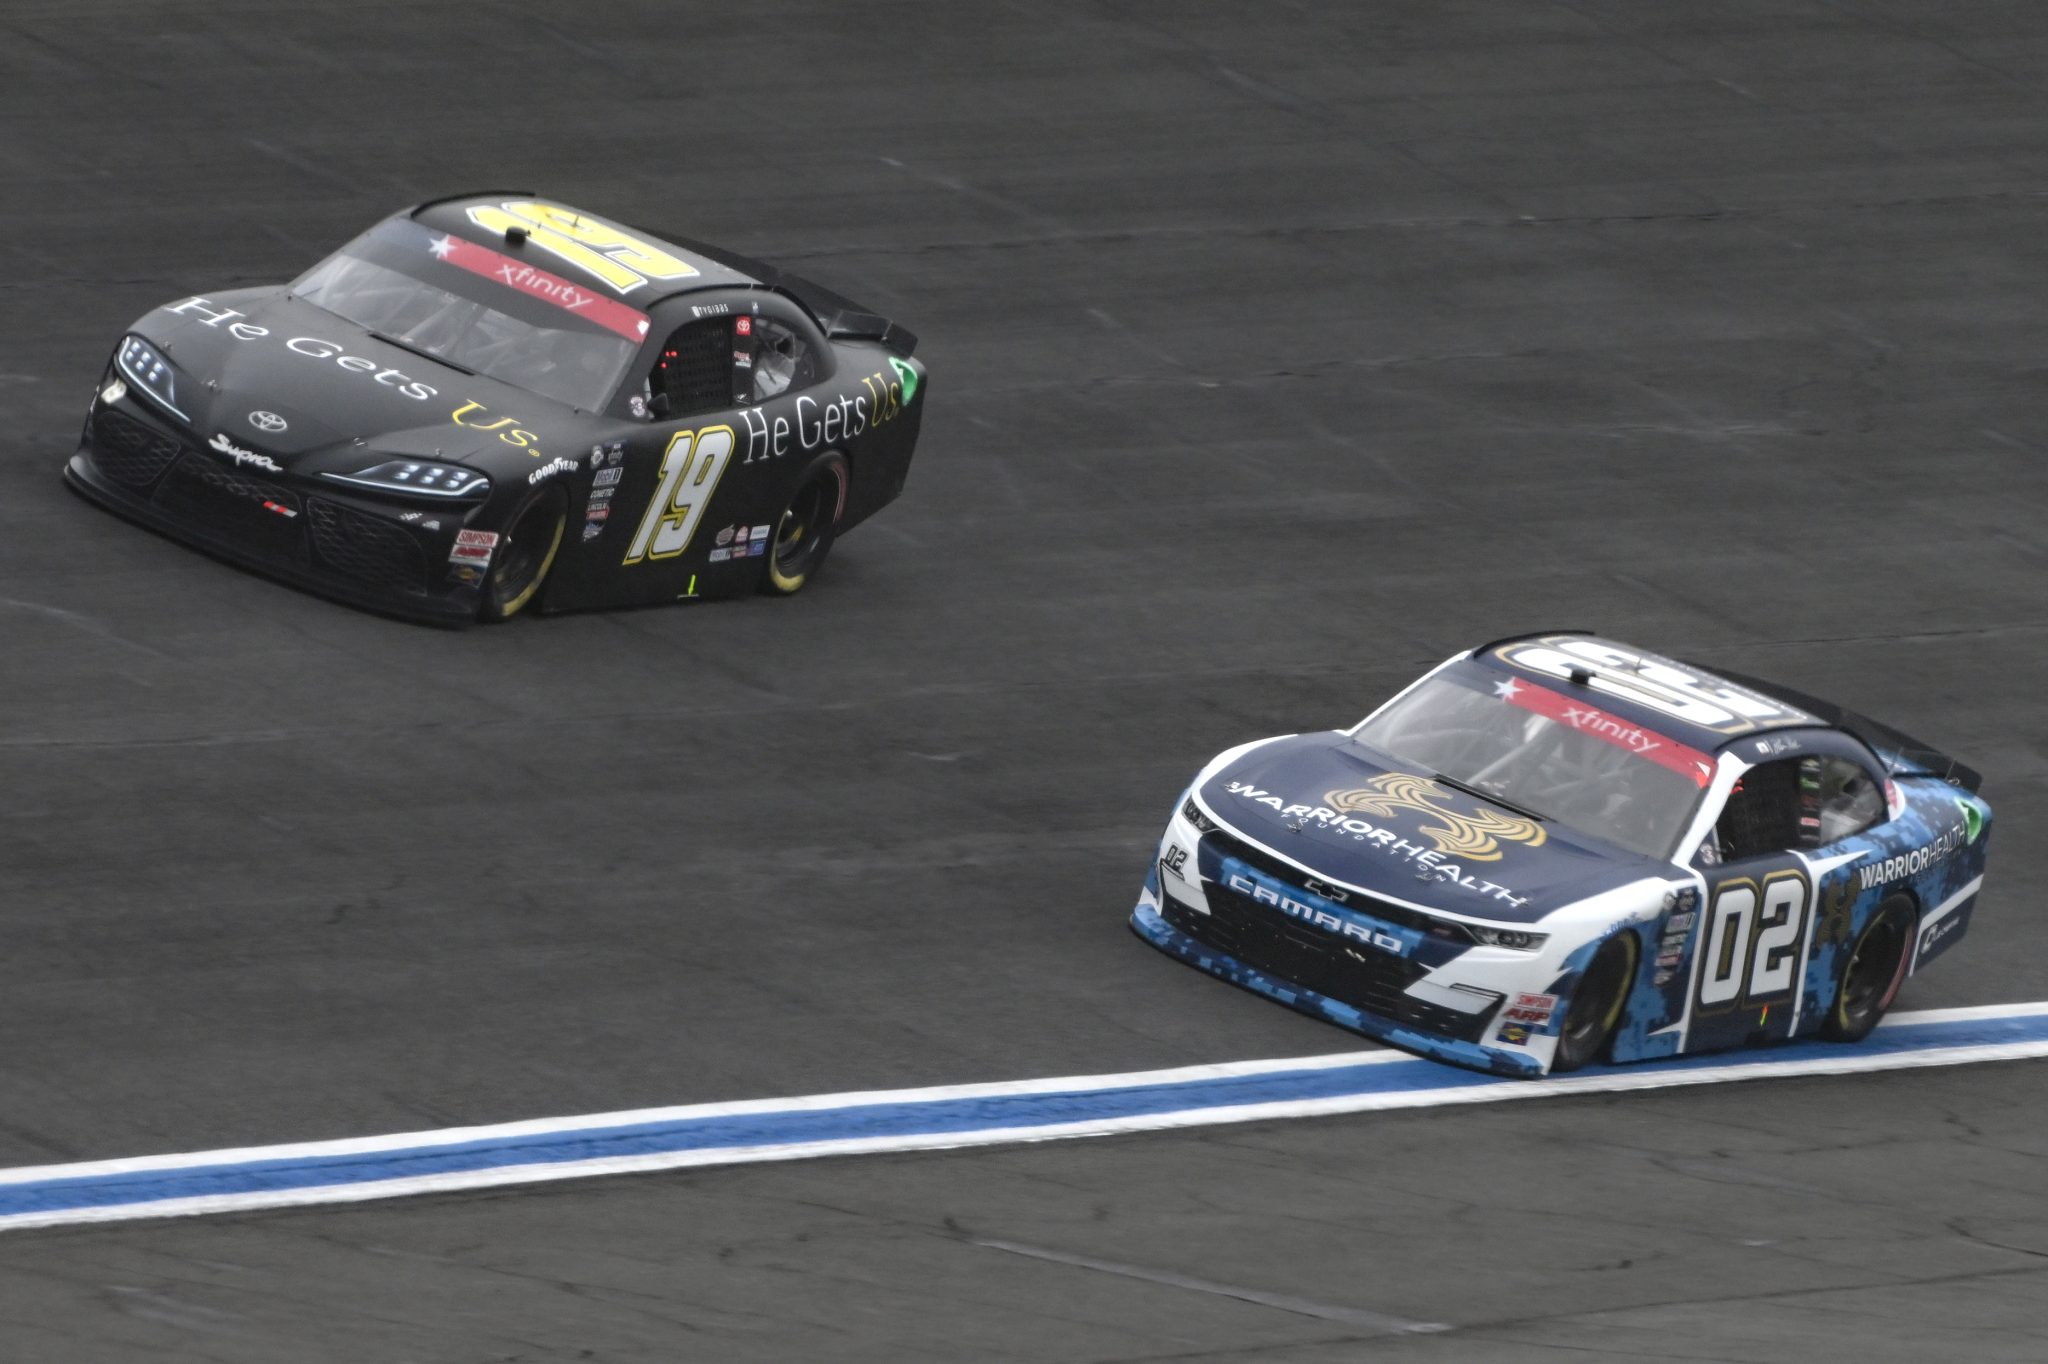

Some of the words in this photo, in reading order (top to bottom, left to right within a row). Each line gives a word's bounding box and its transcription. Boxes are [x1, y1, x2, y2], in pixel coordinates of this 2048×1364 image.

[465, 201, 700, 294] 19
[496, 263, 594, 308] xfinity
[163, 296, 270, 341] He
[286, 337, 439, 401] Gets
[208, 433, 284, 472] Supra
[738, 407, 791, 465] He
[797, 394, 867, 449] Gets
[528, 456, 579, 485] GOODYEAR
[622, 424, 736, 566] 19
[1561, 706, 1660, 753] xfinity
[1165, 843, 1188, 871] 02
[1229, 874, 1403, 953] CAMARO
[1698, 872, 1808, 1008] 02
